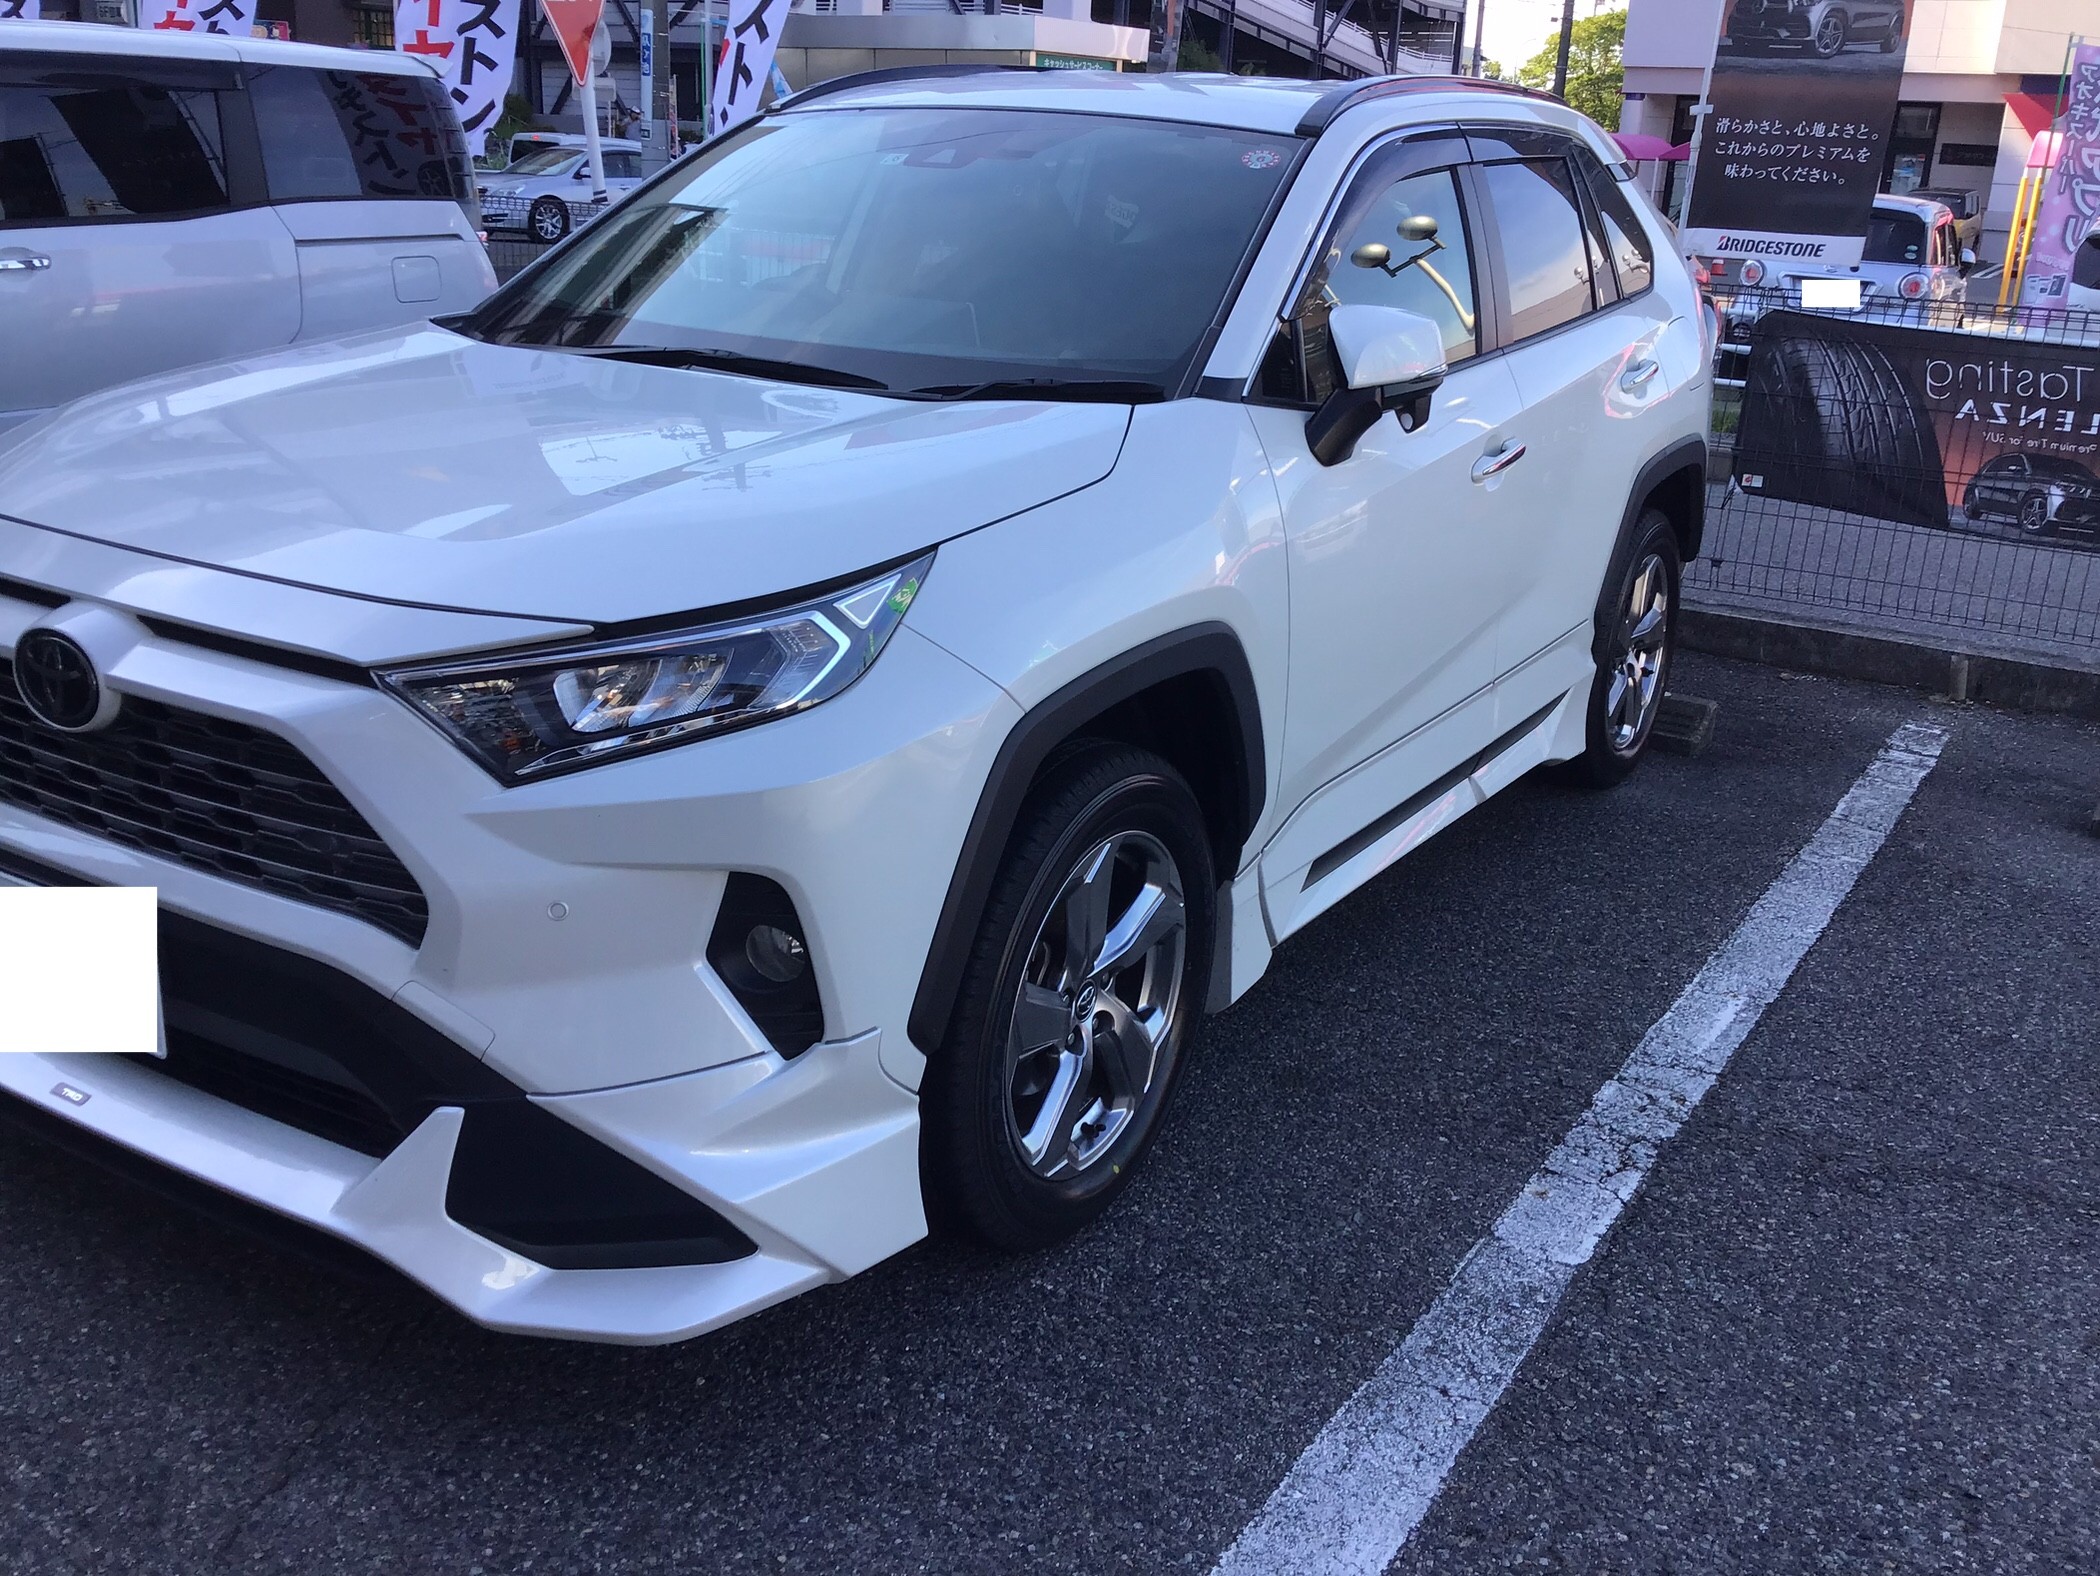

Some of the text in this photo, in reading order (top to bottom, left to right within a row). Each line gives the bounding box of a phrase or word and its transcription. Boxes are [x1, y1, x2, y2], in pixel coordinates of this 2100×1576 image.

[1716, 117, 1879, 141] 滑らかさと、心地よさと。
[1715, 141, 1871, 163] これからのプレミアムを
[1724, 162, 1846, 185] 味わってください。
[1717, 235, 1826, 258] BRIDGESTONE
[61, 1087, 83, 1102] TRD
